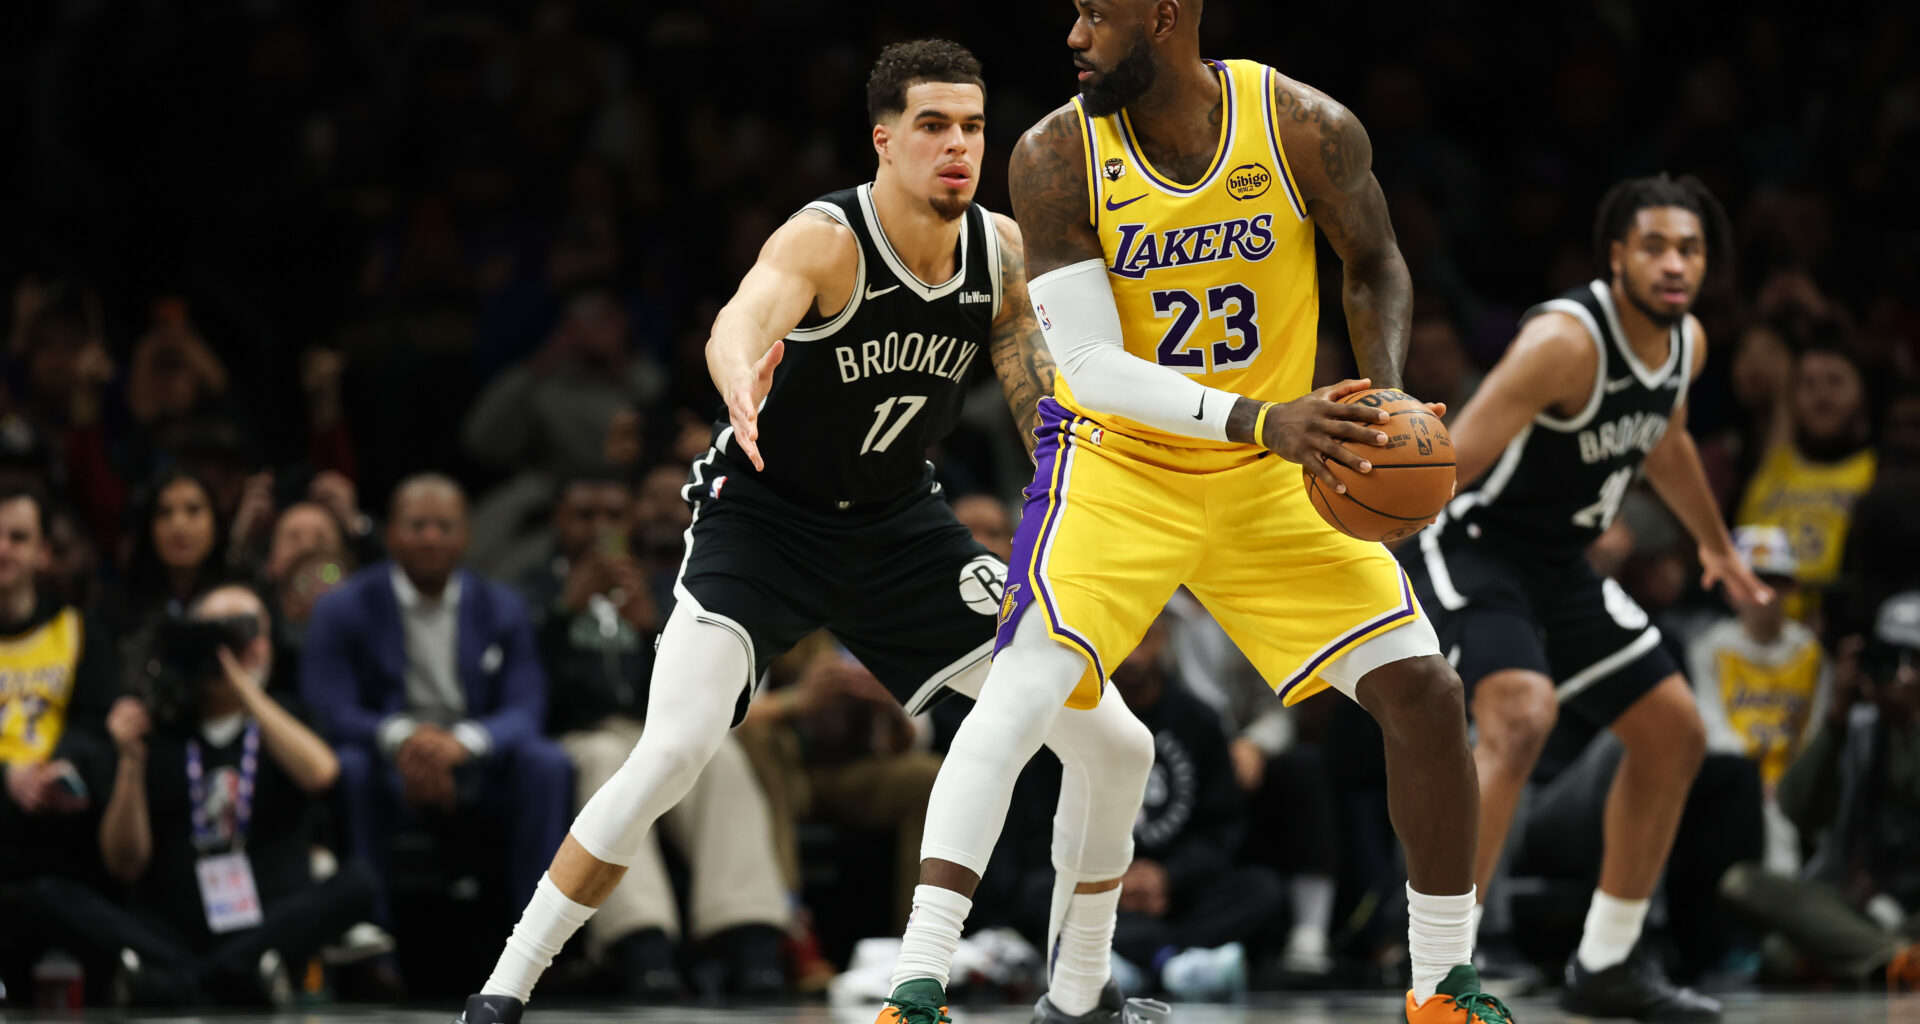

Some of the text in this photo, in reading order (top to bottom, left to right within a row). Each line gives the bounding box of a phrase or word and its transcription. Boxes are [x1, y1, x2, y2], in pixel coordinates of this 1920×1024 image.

[1230, 173, 1268, 188] bibigo
[1108, 213, 1278, 279] LAKERS
[1151, 282, 1262, 375] 23
[859, 395, 929, 457] 17
